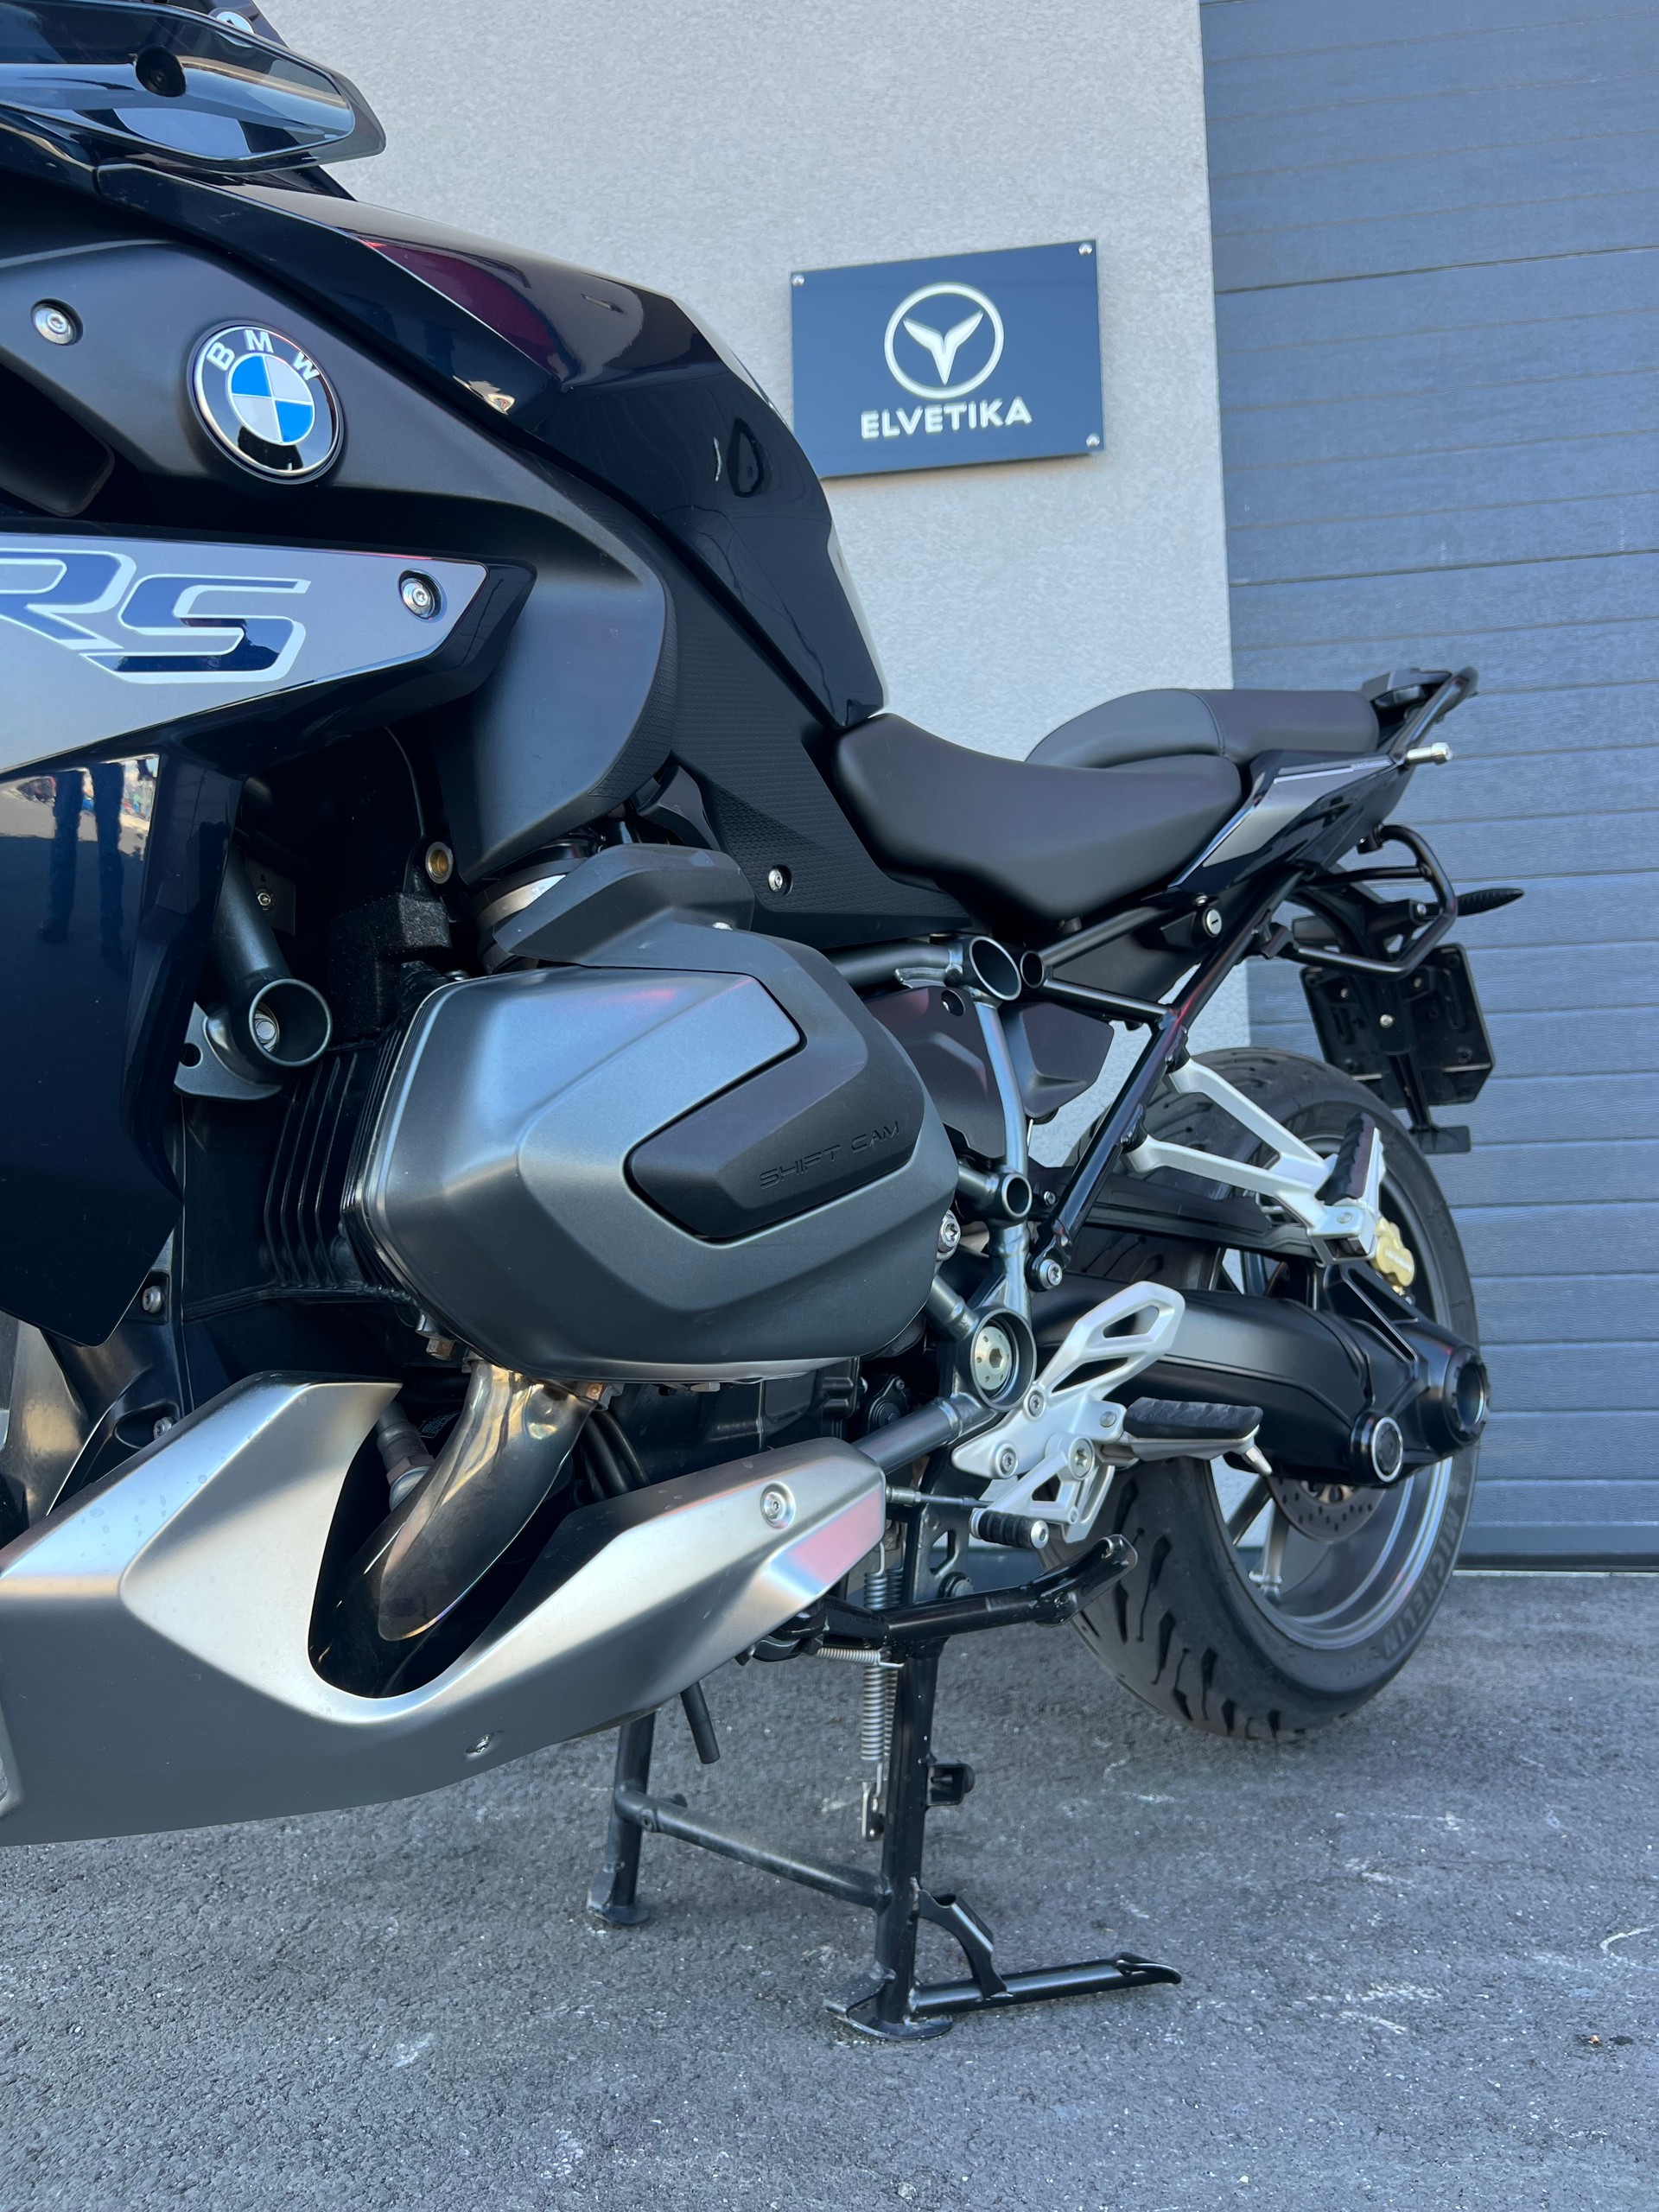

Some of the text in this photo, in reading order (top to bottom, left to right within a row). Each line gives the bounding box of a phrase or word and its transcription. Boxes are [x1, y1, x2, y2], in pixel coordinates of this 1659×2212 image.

[206, 328, 320, 382] BMW
[861, 396, 1033, 440] ELVETIKA
[760, 1121, 899, 1190] SHIFT CAM
[1382, 1506, 1461, 1658] MICHELIN
